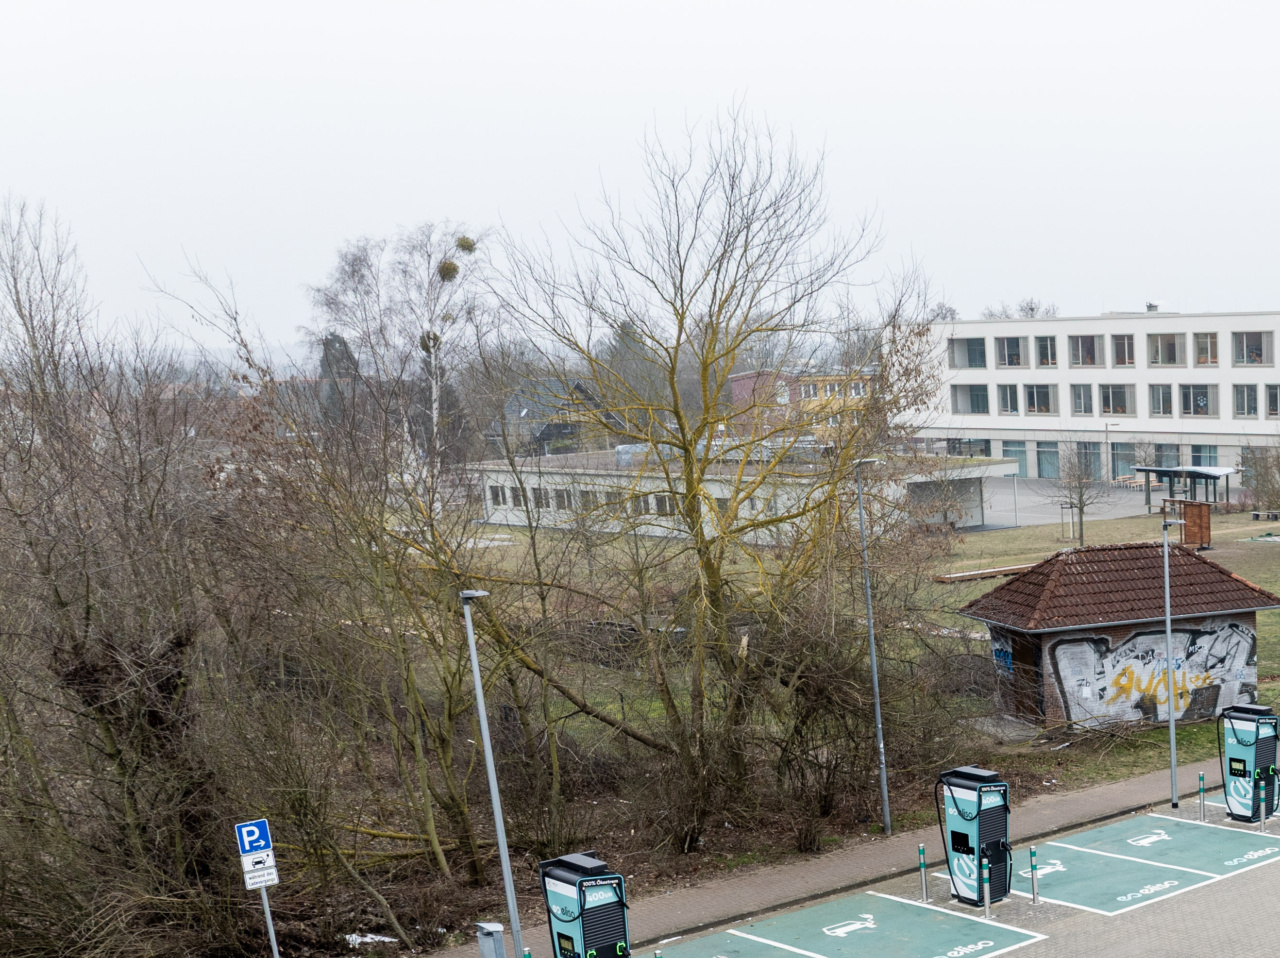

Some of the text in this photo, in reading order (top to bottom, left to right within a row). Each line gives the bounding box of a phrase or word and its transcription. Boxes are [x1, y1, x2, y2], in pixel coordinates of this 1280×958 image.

[242, 826, 260, 850] P
[1139, 880, 1179, 894] eliso
[561, 906, 576, 919] eliso
[947, 940, 994, 957] eliso
